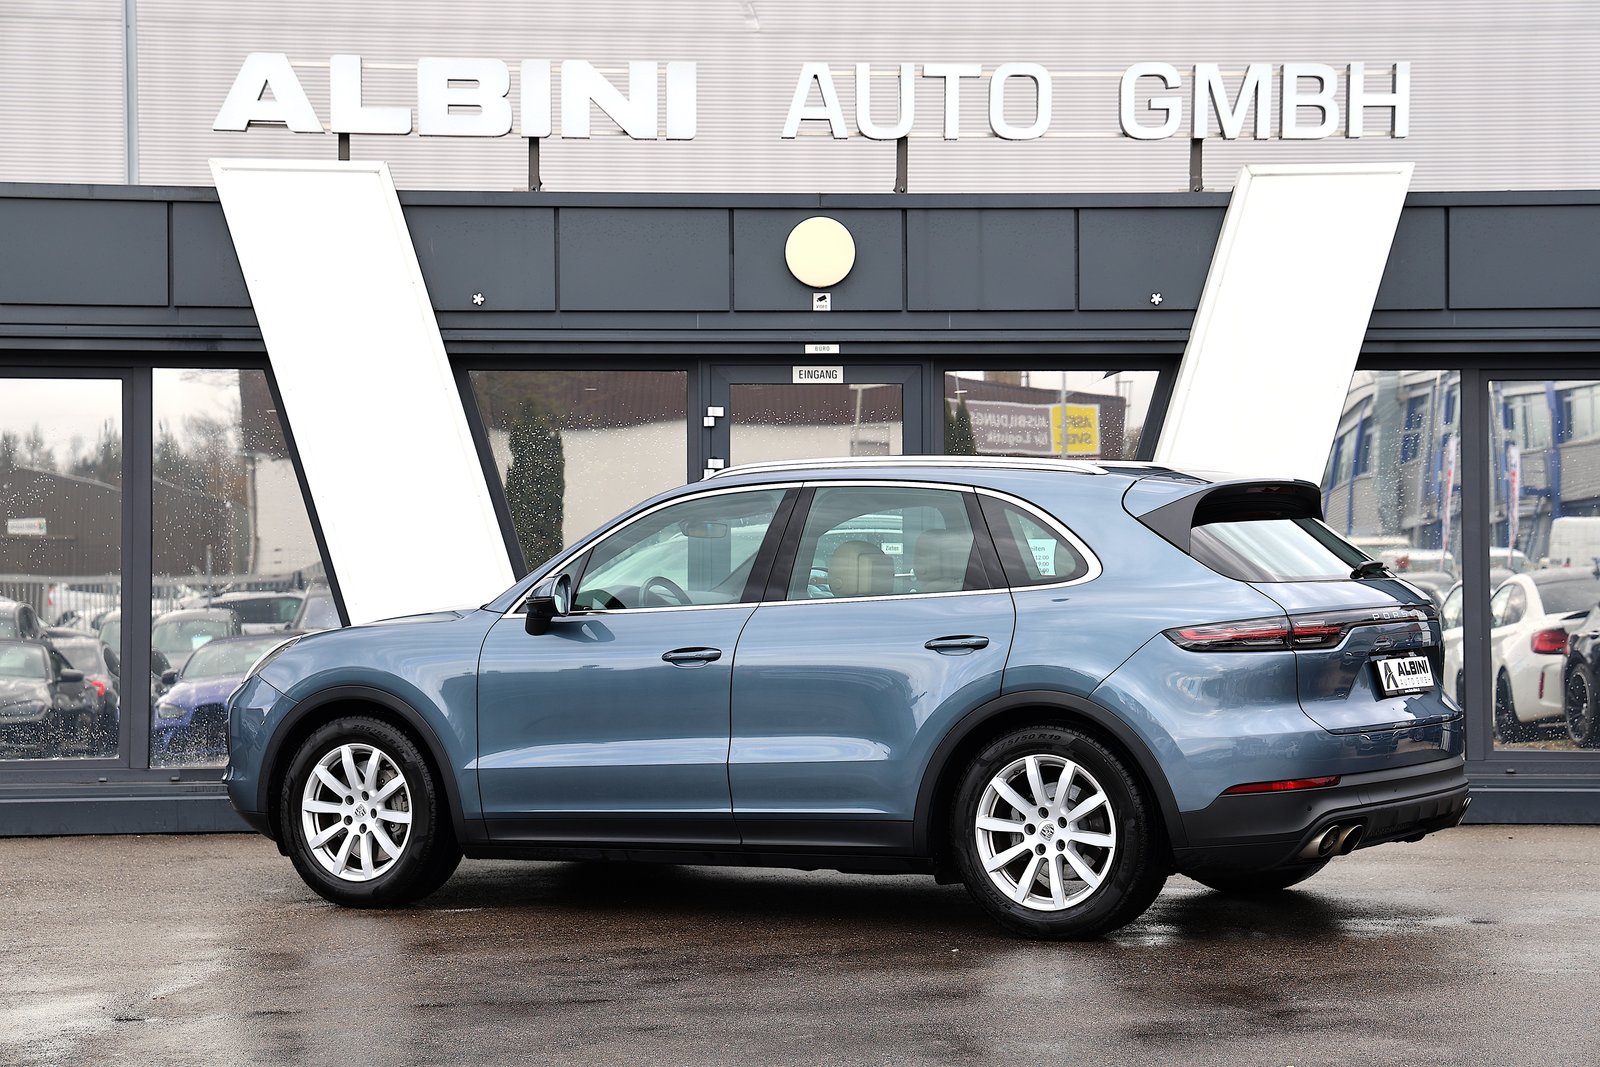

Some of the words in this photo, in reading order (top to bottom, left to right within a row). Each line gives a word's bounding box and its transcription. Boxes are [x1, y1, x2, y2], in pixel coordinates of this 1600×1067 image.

[213, 53, 697, 140] ALBINI
[781, 61, 1053, 140] AUTO
[1119, 61, 1411, 139] GMBH
[798, 369, 838, 380] EINGANG
[1398, 660, 1429, 676] ALBINI
